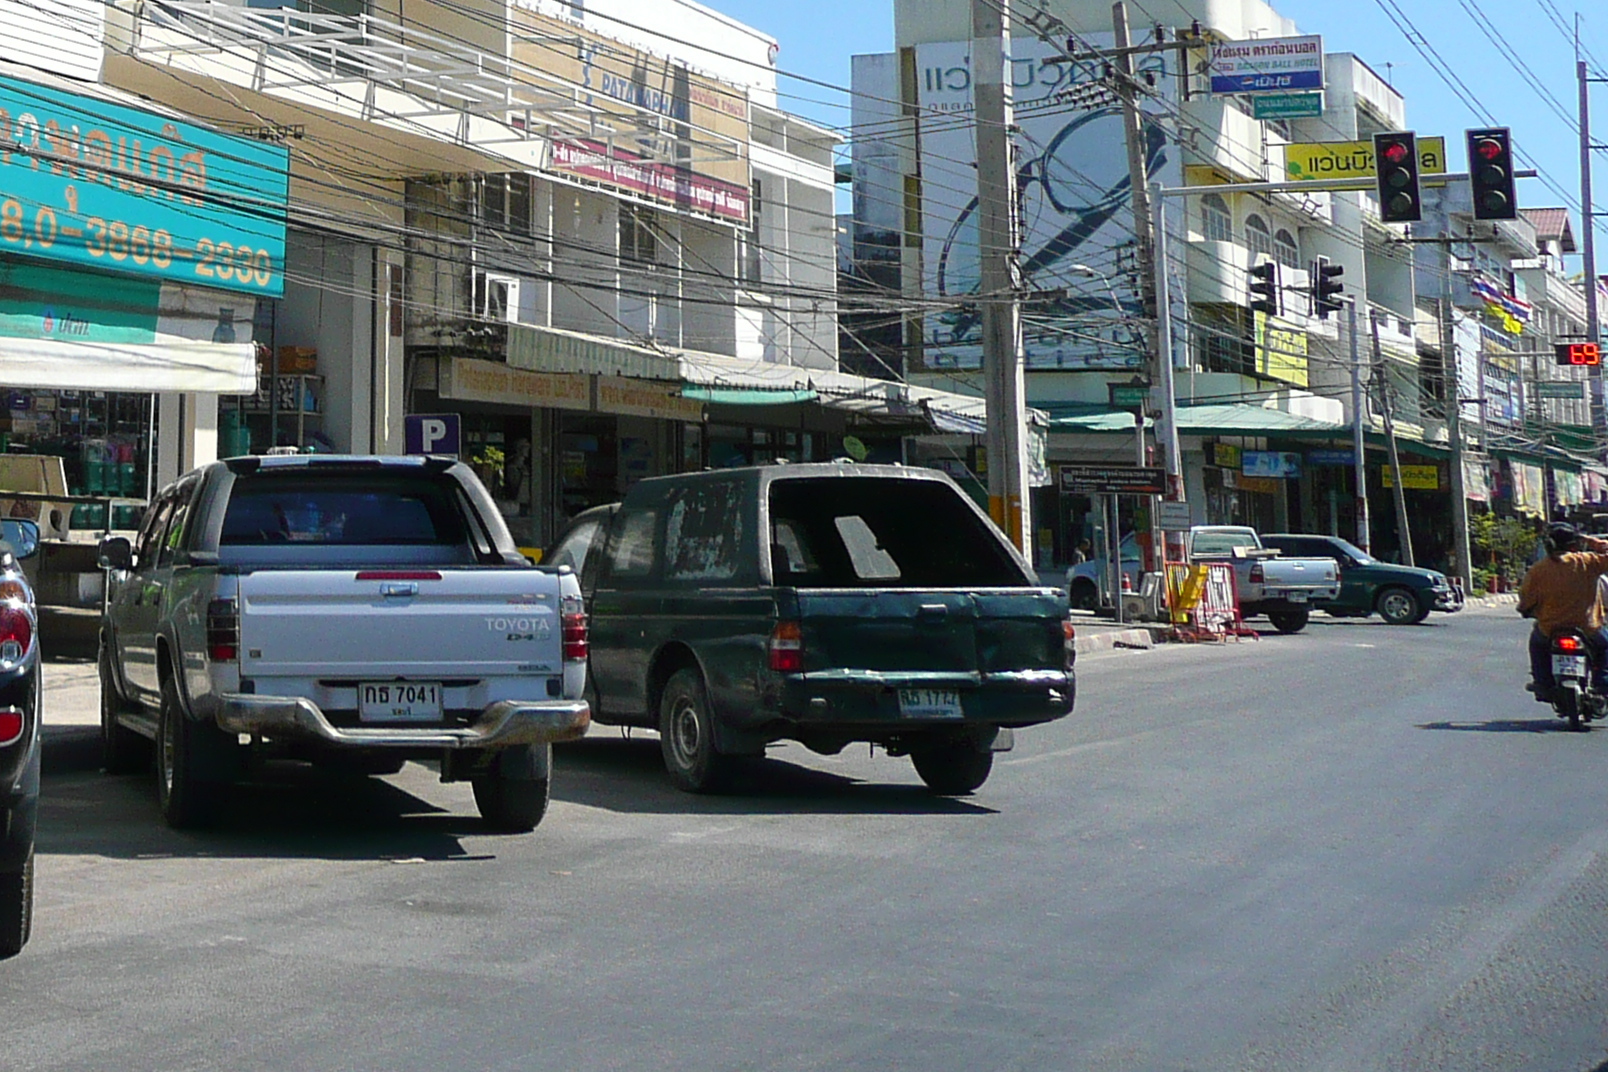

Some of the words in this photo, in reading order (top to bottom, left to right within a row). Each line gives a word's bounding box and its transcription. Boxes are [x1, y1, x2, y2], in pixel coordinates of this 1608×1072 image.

[1570, 343, 1600, 365] 69
[422, 418, 447, 452] P
[484, 617, 550, 632] TOYOTA
[395, 686, 436, 704] 7041
